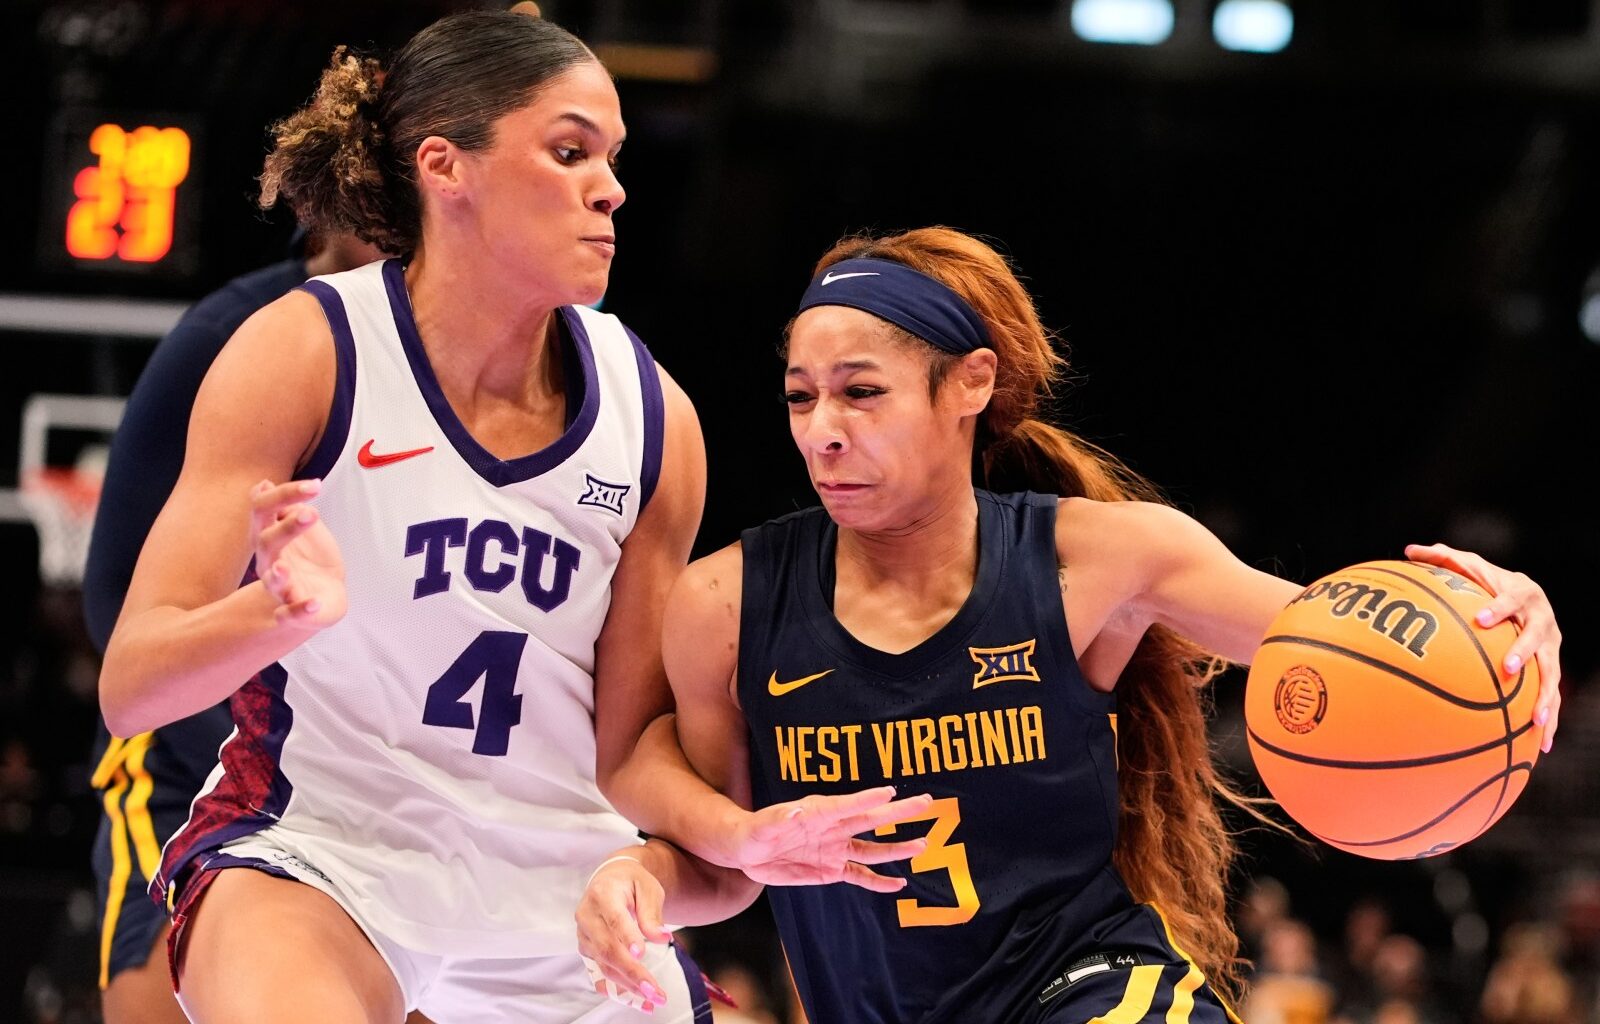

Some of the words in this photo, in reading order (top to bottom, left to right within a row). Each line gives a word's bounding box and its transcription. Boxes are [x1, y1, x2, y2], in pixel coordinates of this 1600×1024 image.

[404, 517, 581, 613] TCU
[422, 630, 529, 756] 4
[775, 724, 862, 782] WEST
[872, 705, 1047, 779] VIRGINIA
[875, 797, 981, 927] 3
[1116, 955, 1135, 965] 44
